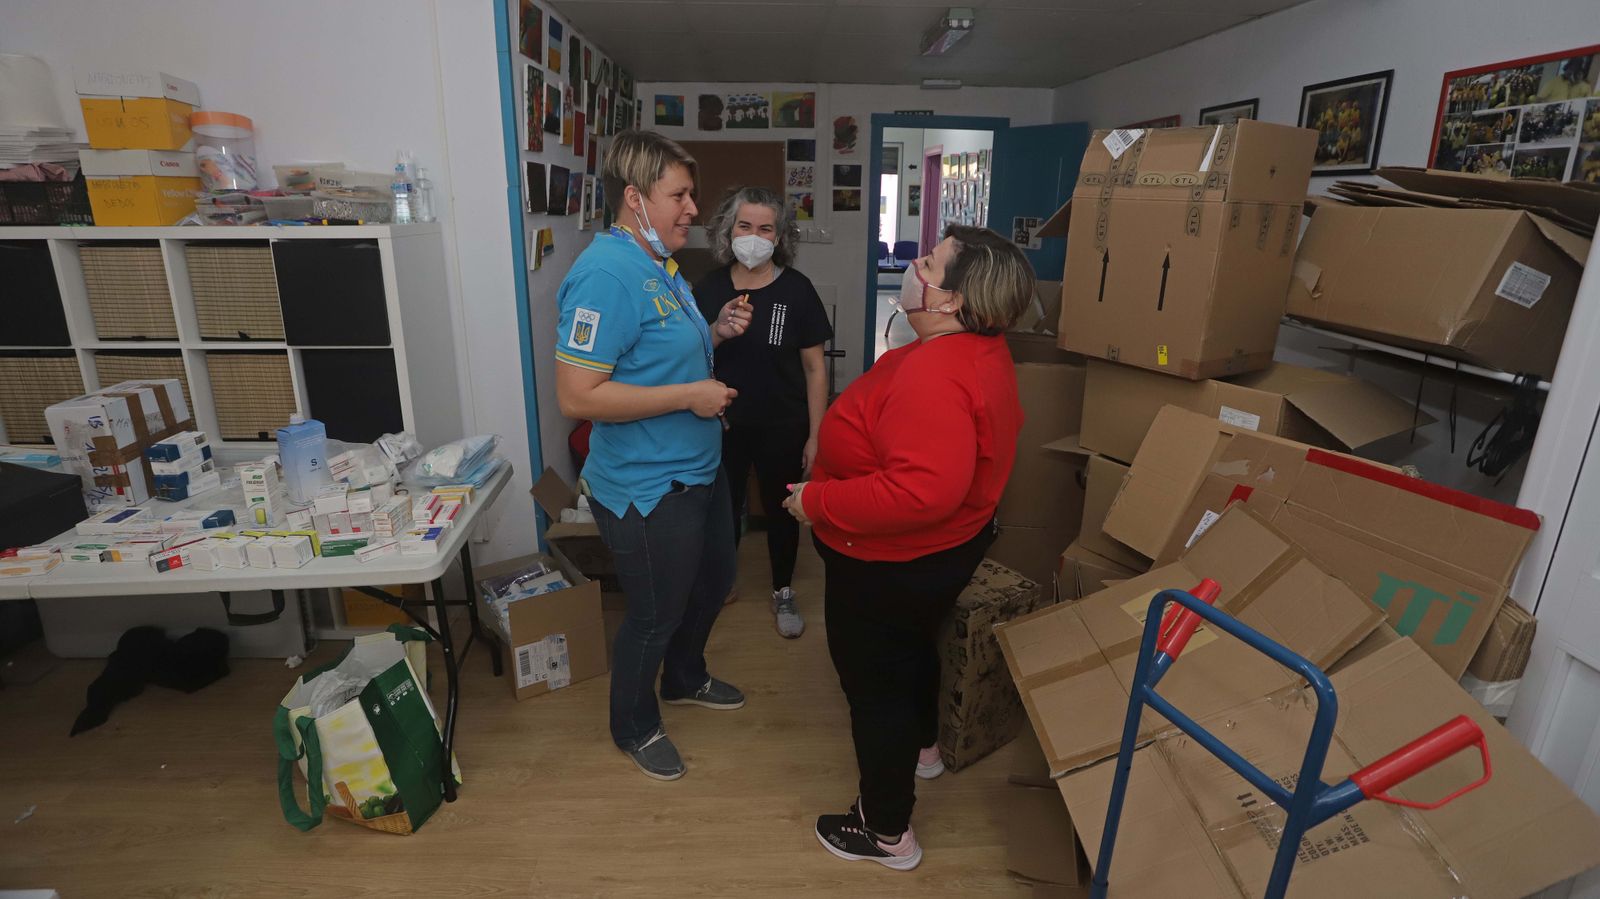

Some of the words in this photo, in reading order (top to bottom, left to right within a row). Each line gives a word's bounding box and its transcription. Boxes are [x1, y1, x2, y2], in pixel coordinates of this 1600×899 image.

[160, 160, 180, 168] Canon
[1190, 212, 1198, 234] STL
[310, 458, 318, 466] S
[1344, 813, 1354, 824] IN
[1350, 822, 1370, 843] MADE
[827, 833, 847, 850] FILA
[1298, 850, 1311, 863] ITE
